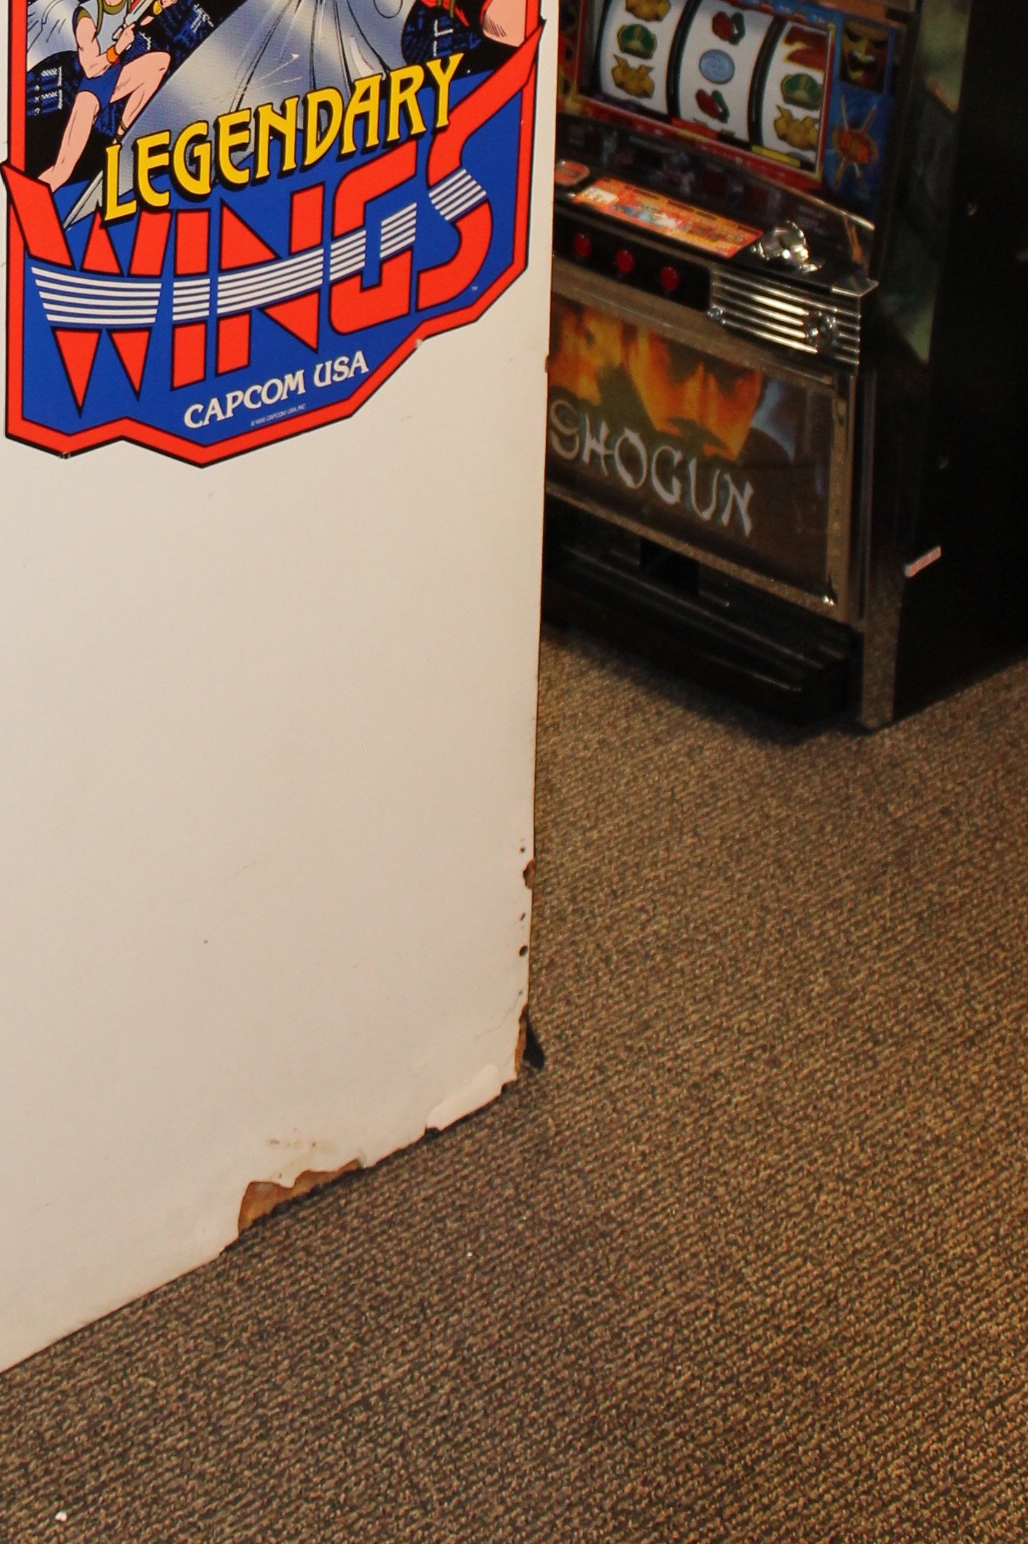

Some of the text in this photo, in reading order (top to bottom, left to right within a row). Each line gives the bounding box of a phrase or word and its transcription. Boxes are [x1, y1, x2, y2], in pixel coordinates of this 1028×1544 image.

[99, 52, 466, 224] LEGENDARY
[0, 22, 542, 414] WINGS
[183, 349, 370, 430] CAPCOM USA
[549, 398, 755, 538] SHOGUN
